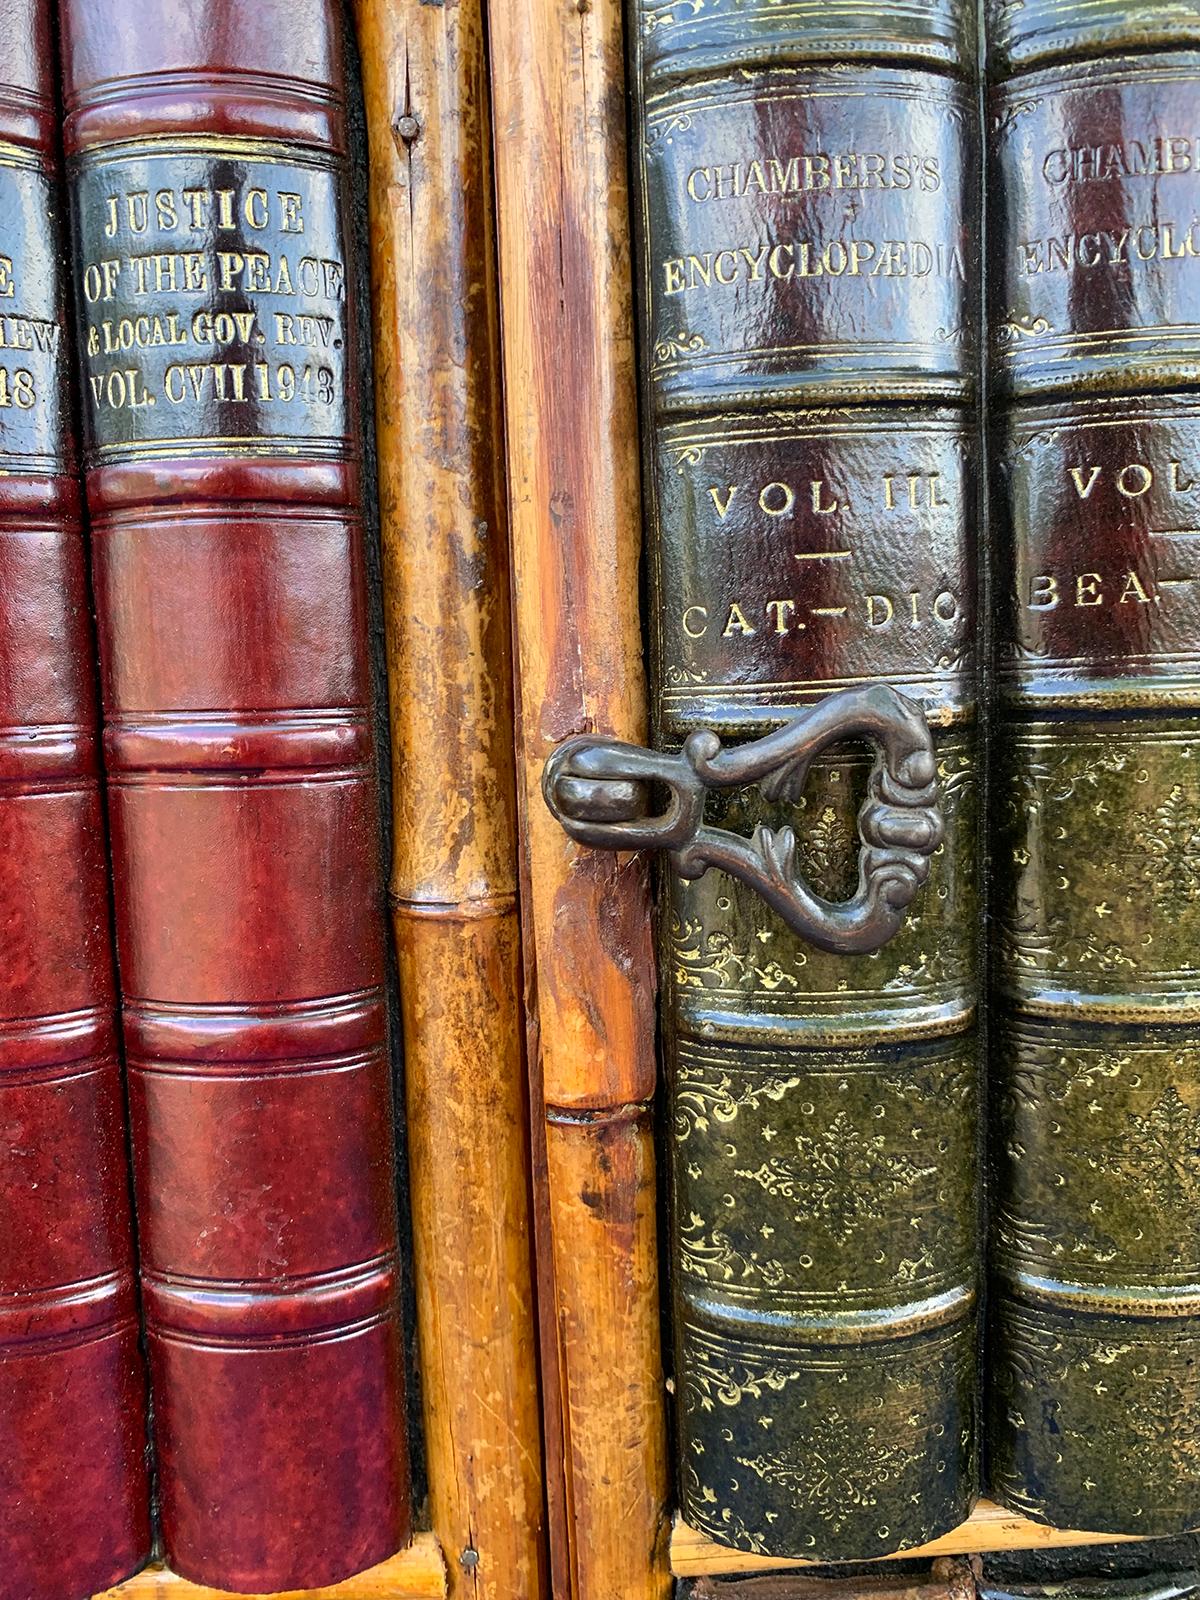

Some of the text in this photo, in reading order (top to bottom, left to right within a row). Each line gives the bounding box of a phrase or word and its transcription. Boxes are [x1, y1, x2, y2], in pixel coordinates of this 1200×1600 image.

[686, 153, 941, 203] CHAMBERS'S
[1042, 136, 1200, 186] CHAMB
[104, 187, 305, 238] JUSTICE
[83, 250, 346, 304] OF THE PEACE
[662, 240, 967, 296] ENCYCLOPÆDIA
[102, 311, 188, 355] LOCAL
[192, 311, 266, 346] GOV.
[272, 312, 344, 350] REV.
[89, 368, 156, 410] VOL.
[163, 362, 249, 405] CVII
[707, 480, 850, 520] VOL.
